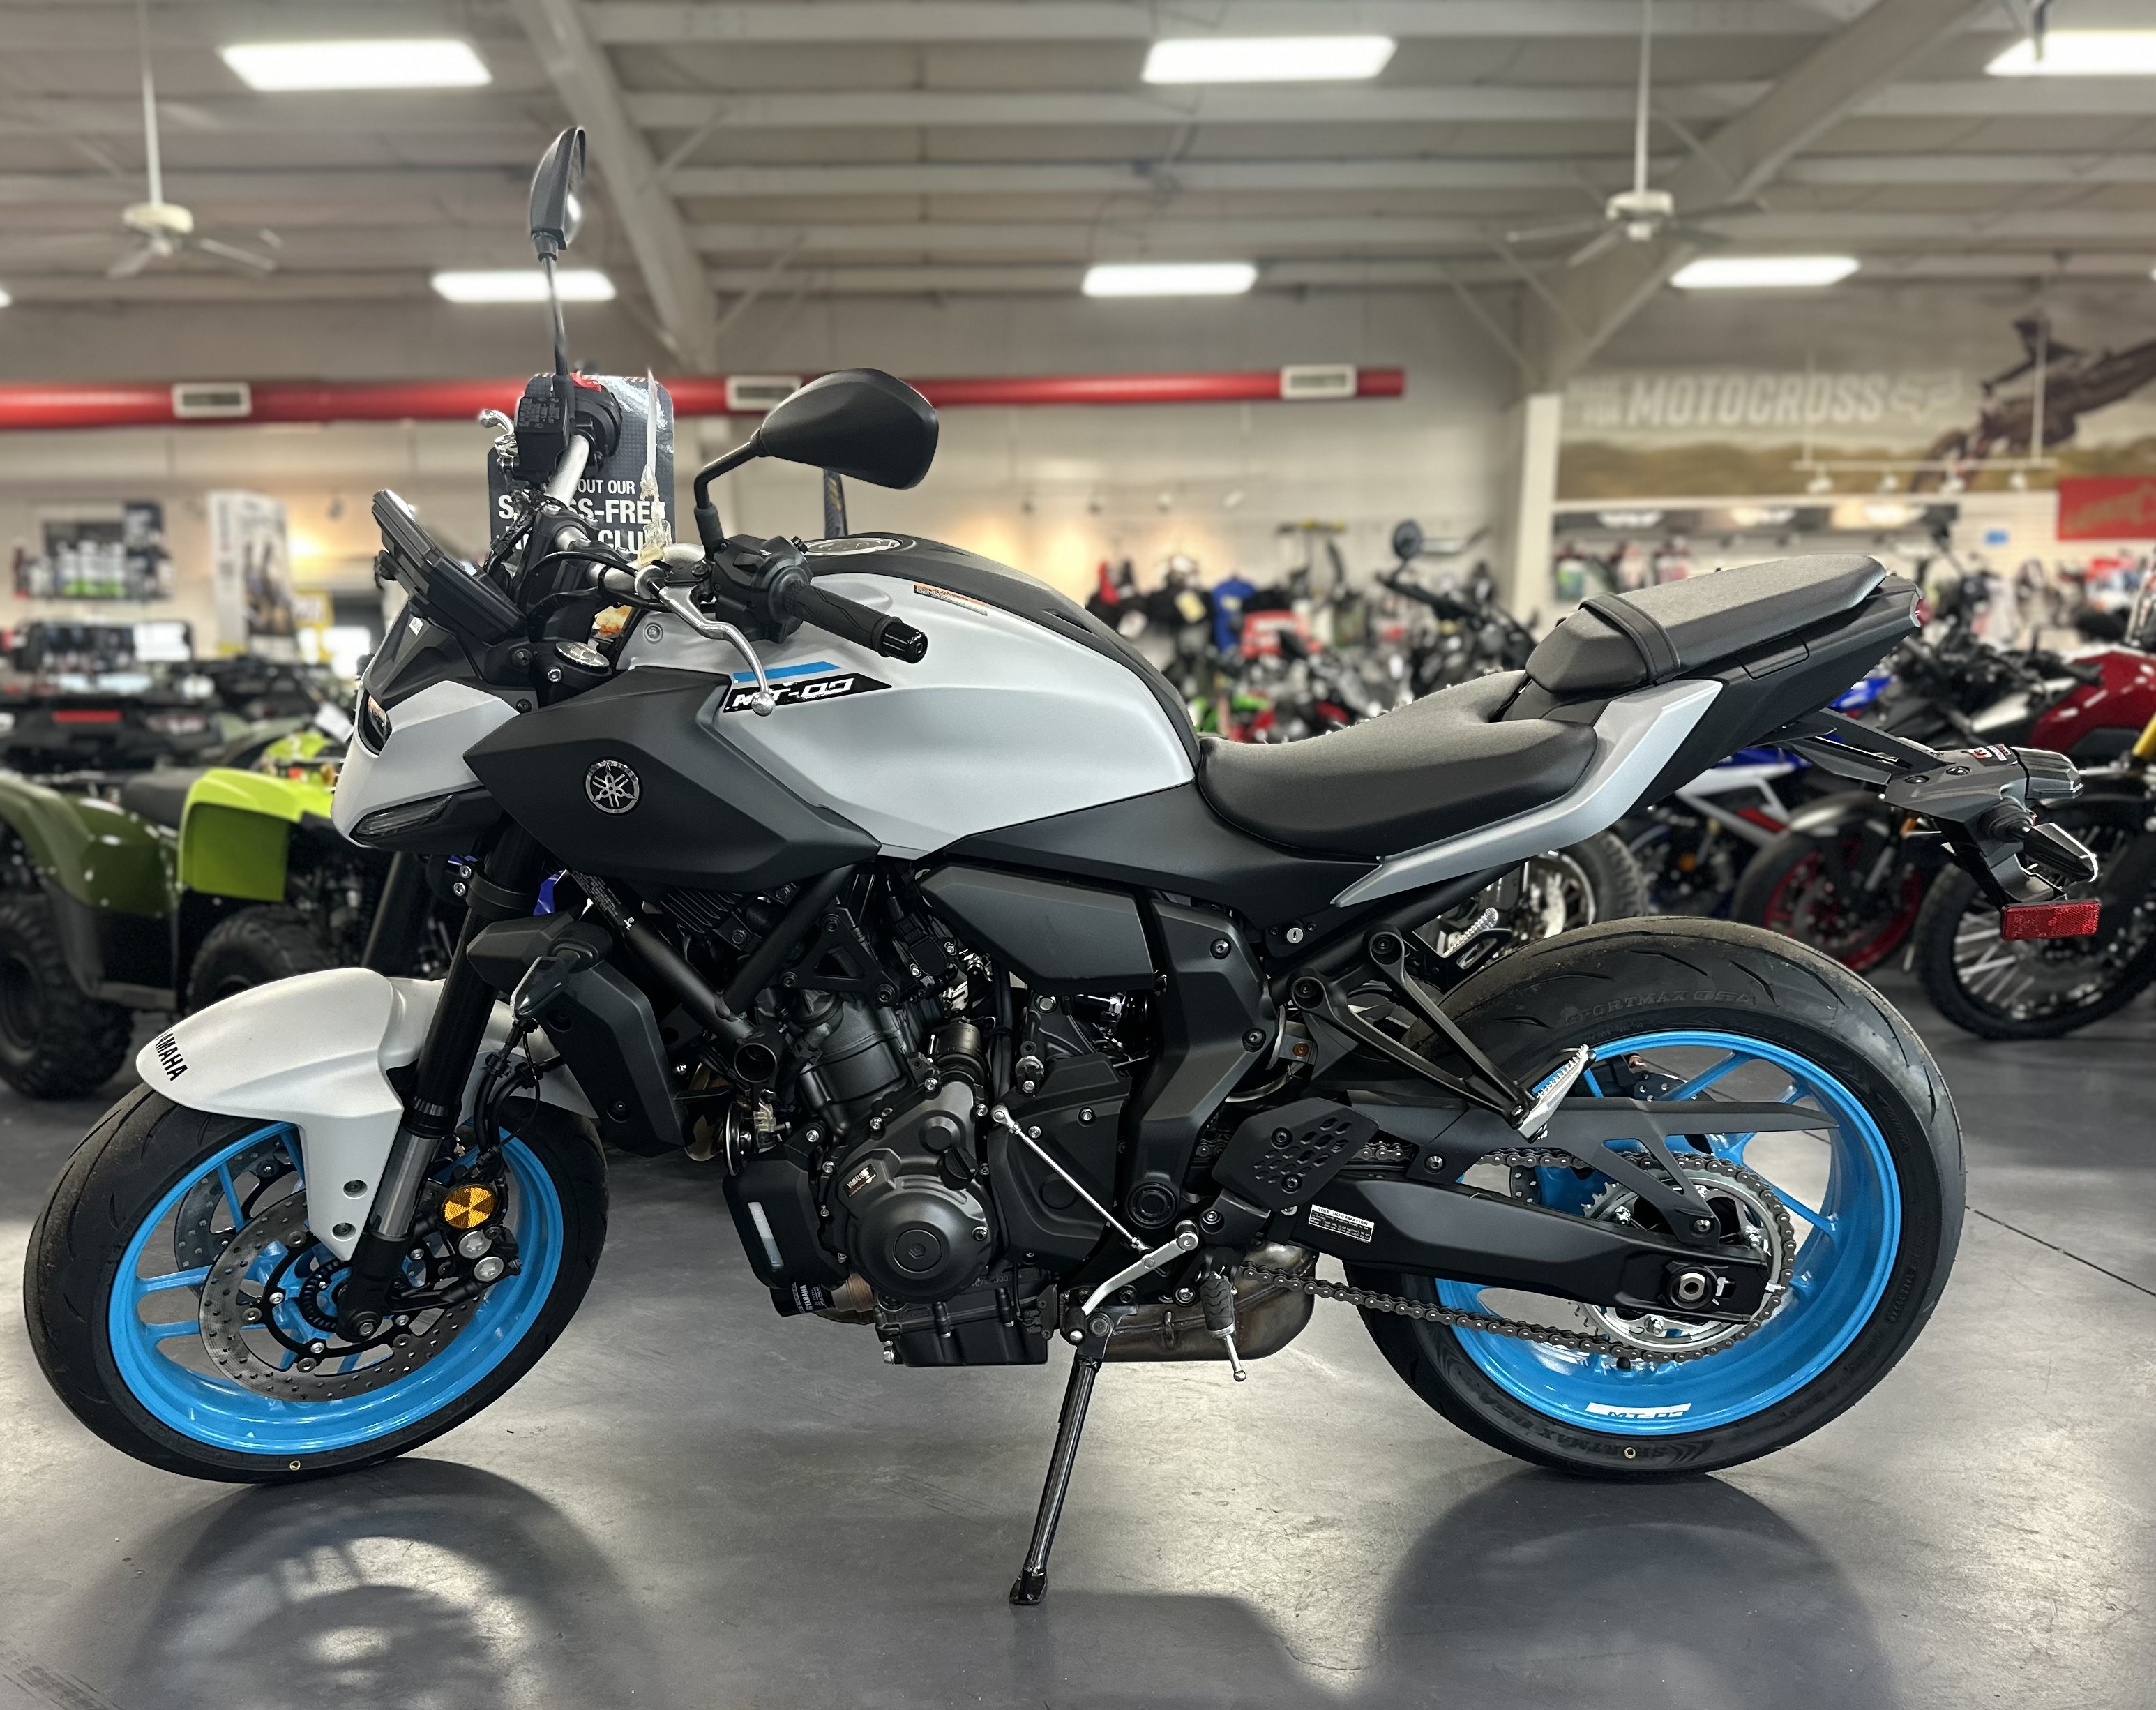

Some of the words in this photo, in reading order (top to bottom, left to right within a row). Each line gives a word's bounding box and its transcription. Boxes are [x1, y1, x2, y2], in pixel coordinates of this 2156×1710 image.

[1626, 373, 1888, 428] MOTOCROSS
[577, 479, 603, 493] OUT
[608, 479, 635, 495] OUR
[598, 529, 649, 555] CLU
